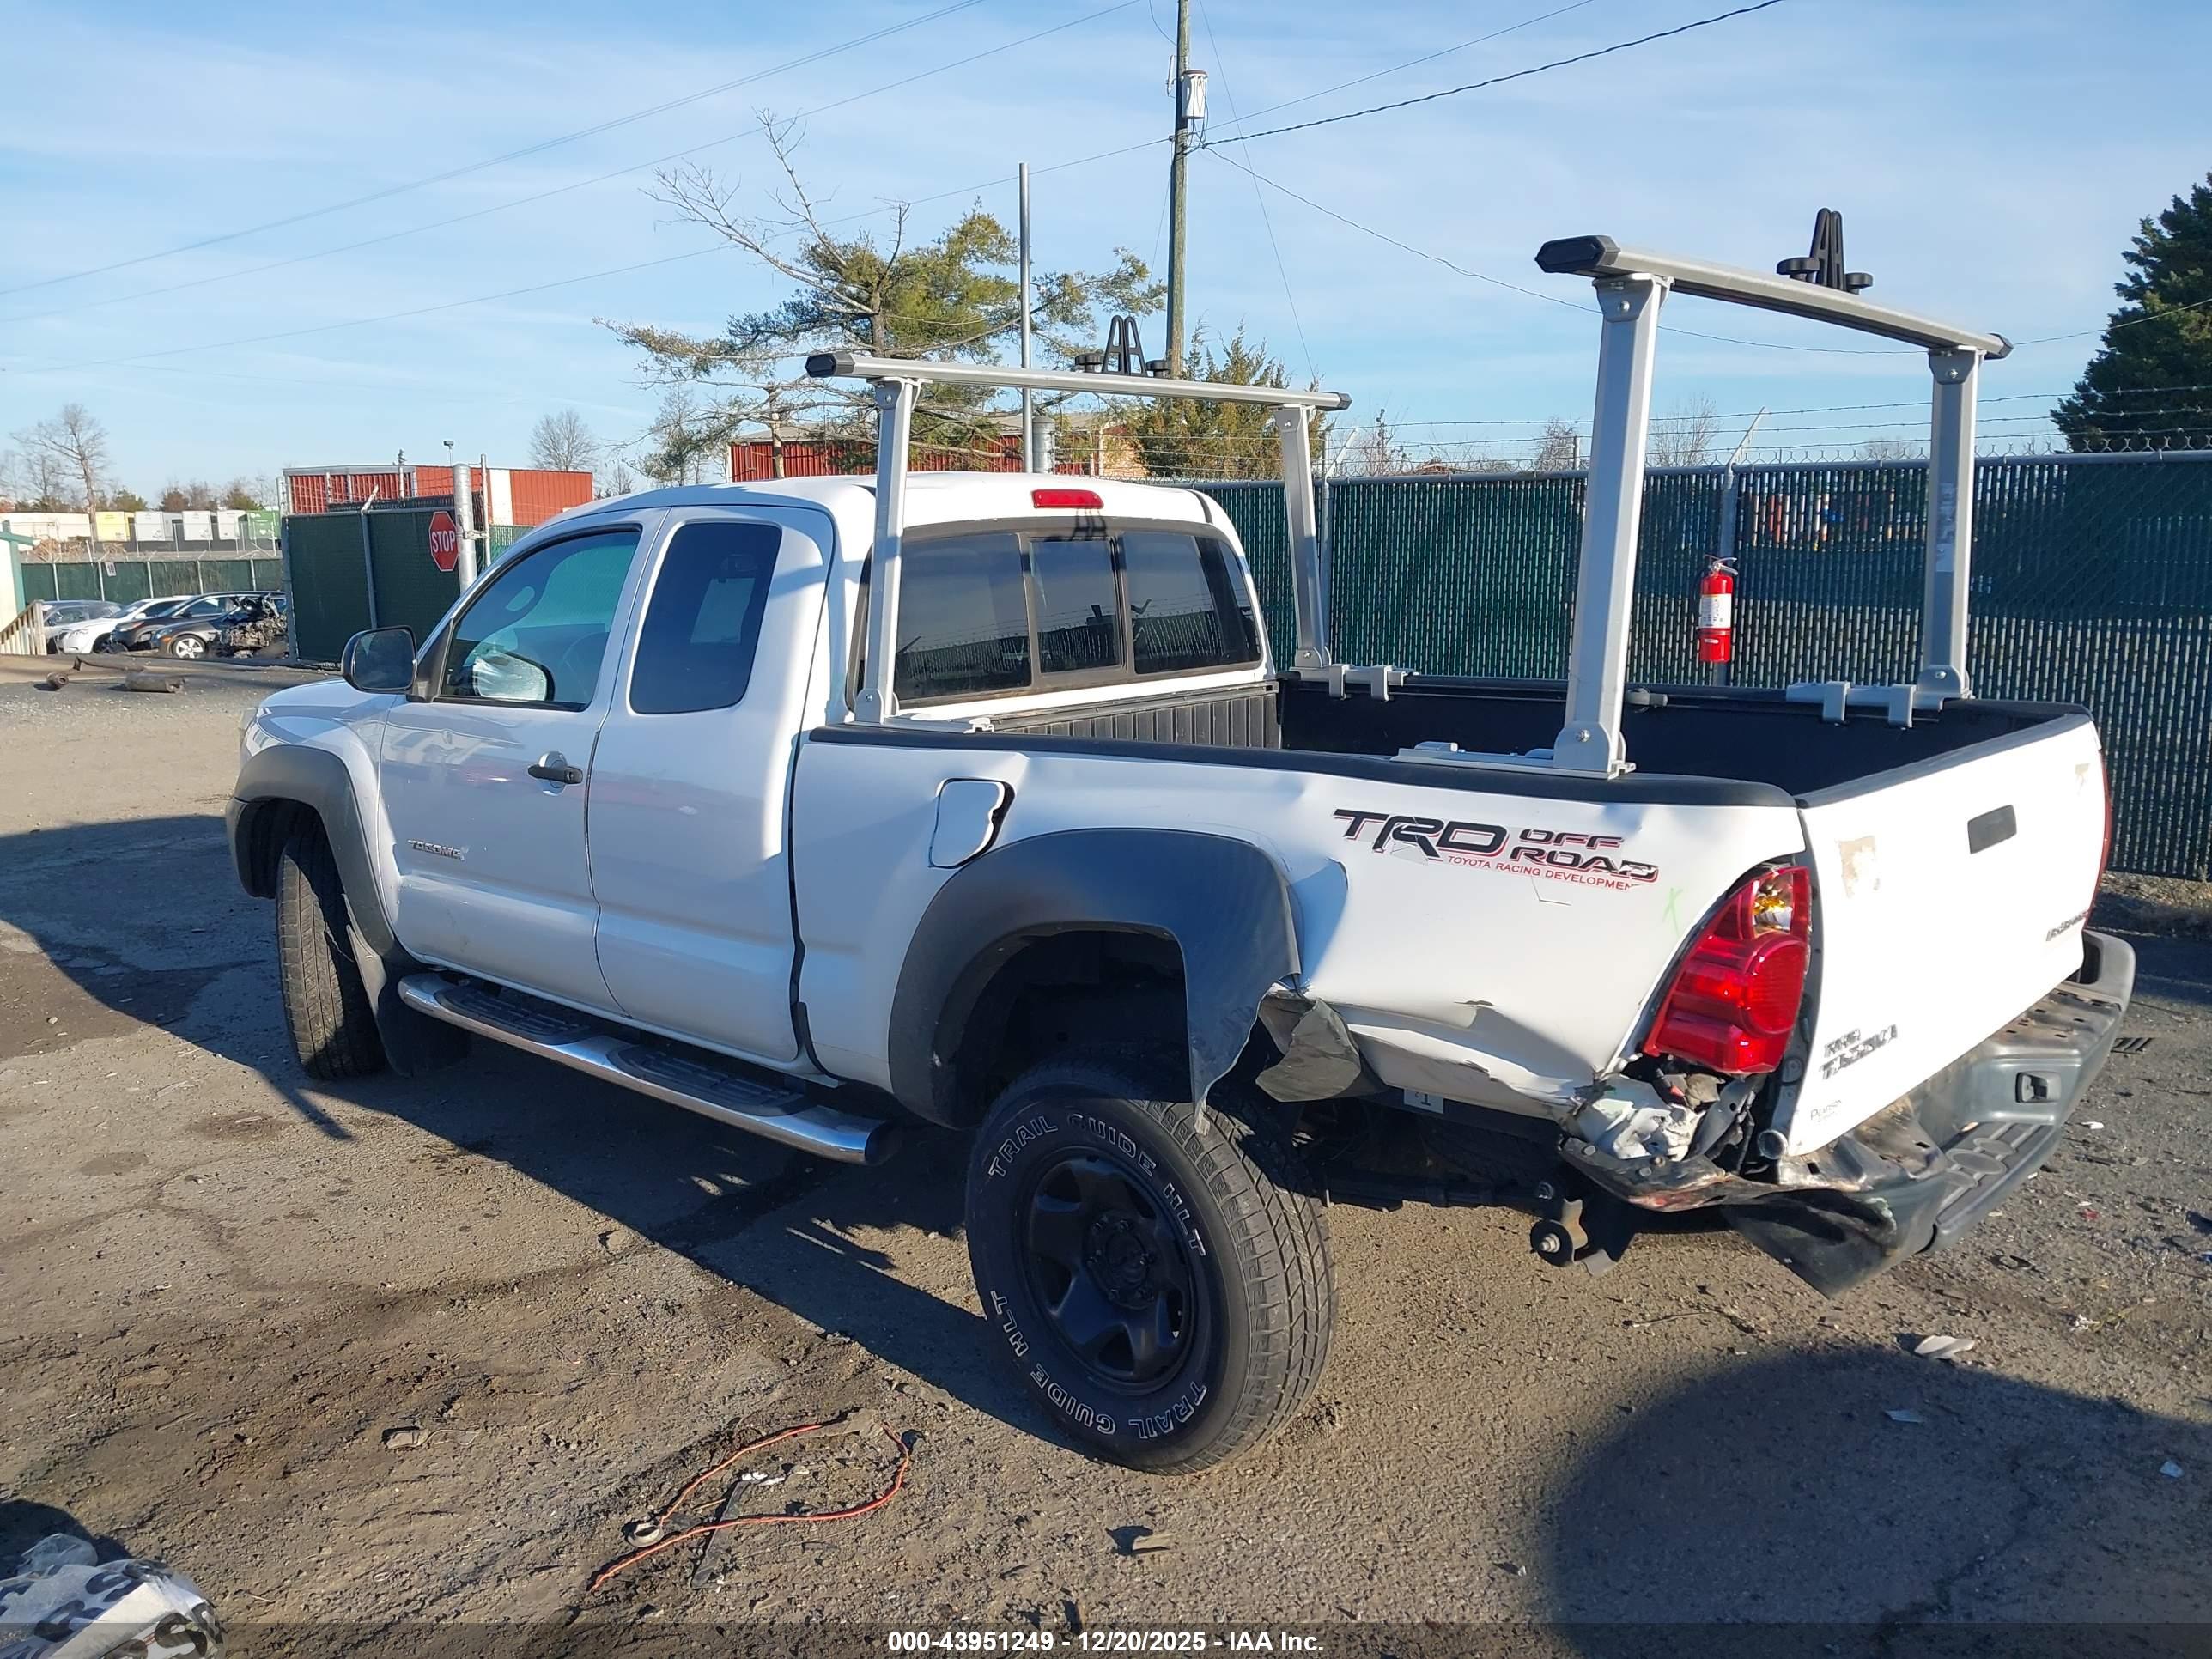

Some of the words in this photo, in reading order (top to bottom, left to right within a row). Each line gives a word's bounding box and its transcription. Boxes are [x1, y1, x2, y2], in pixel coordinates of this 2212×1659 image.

[431, 530, 455, 552] STOP
[1334, 808, 1510, 861] TRD
[1519, 829, 1624, 849] OFF
[1448, 856, 1491, 869] TOYOTA
[1496, 862, 1540, 876] RACING
[1546, 870, 1636, 890] DEVELOPMEN
[1510, 846, 1658, 883] ROAD
[988, 1115, 1059, 1177] TRAIL
[1068, 1113, 1157, 1177] GUIDE
[1163, 1182, 1206, 1256] HLT
[990, 1291, 1029, 1357] HLT
[1030, 1364, 1116, 1435] GUIDE
[1128, 1381, 1208, 1439] TRAIL
